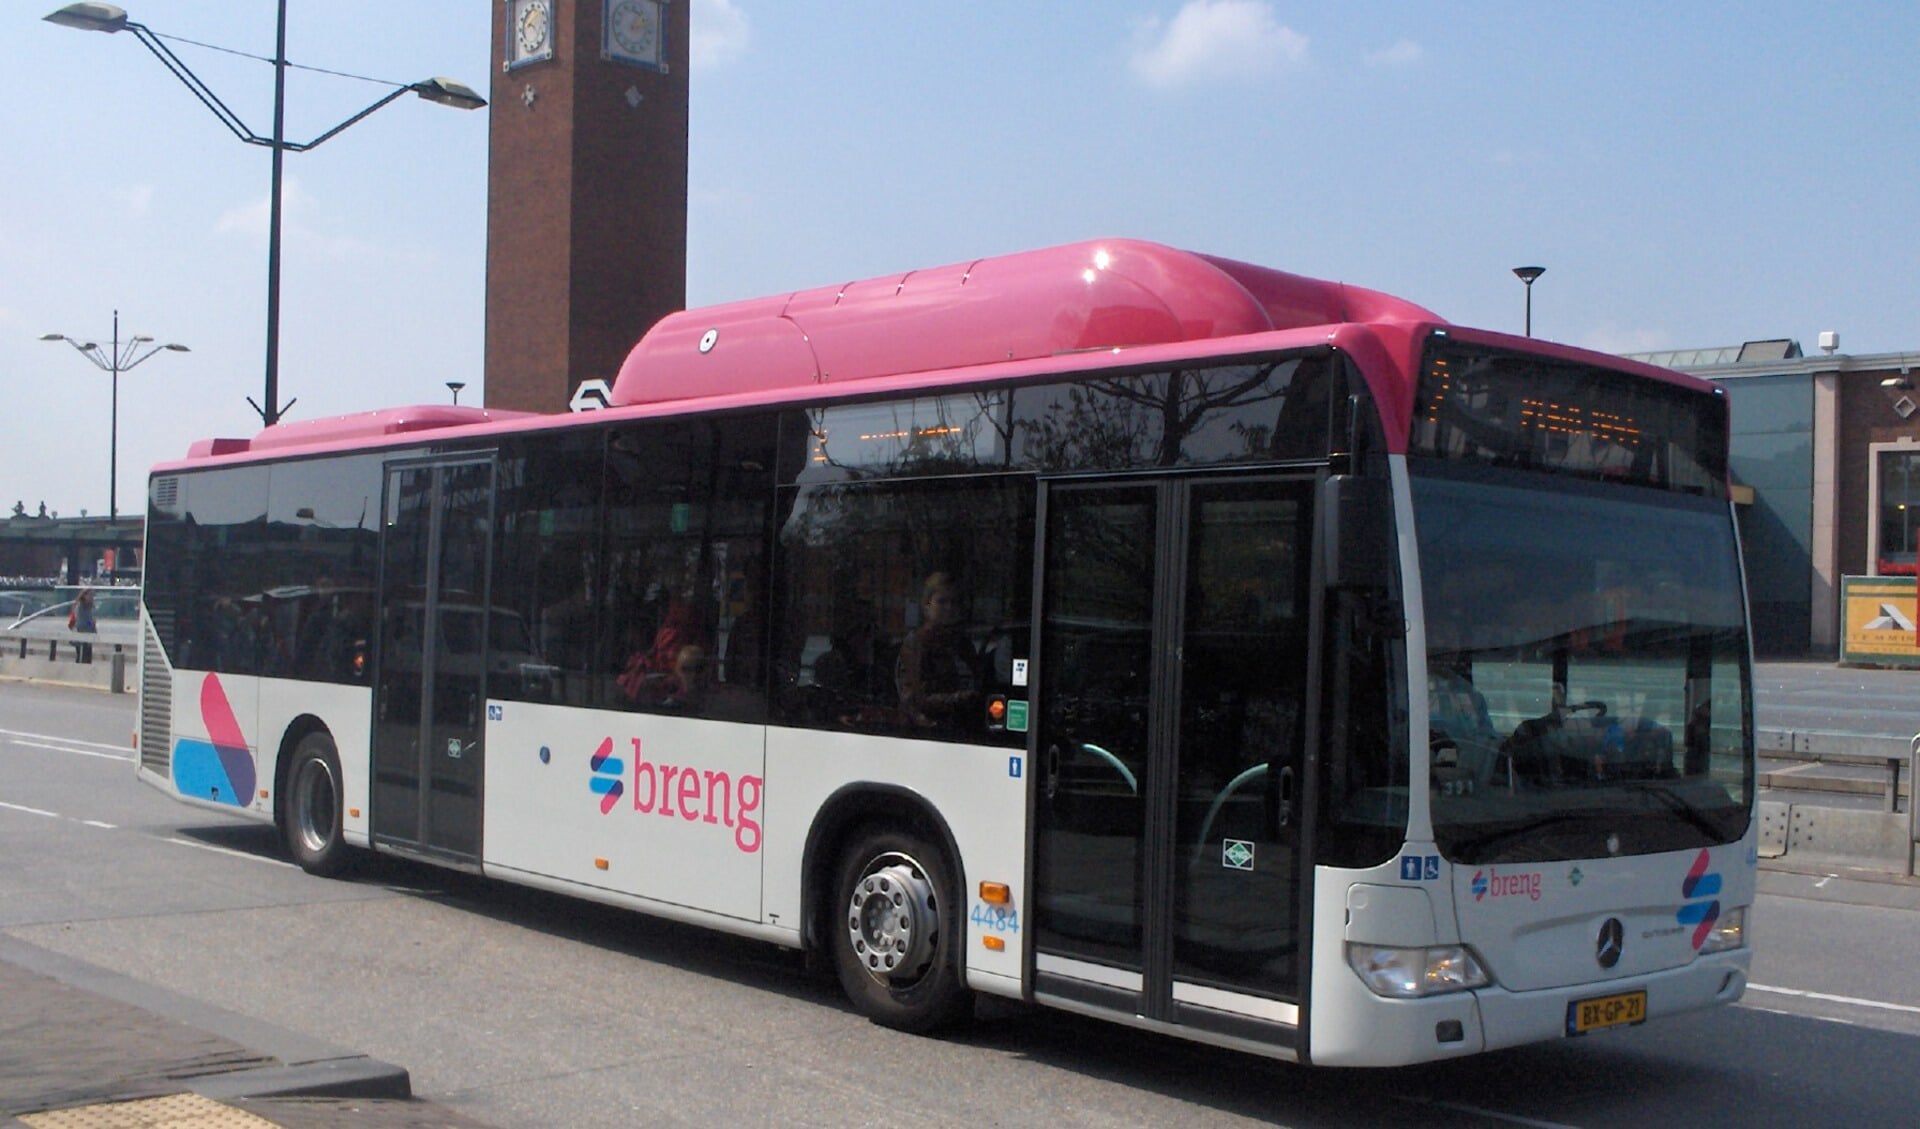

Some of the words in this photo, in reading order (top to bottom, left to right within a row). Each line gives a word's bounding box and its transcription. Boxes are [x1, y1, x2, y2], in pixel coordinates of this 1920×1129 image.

[631, 737, 763, 853] breng
[1490, 867, 1542, 901] breng
[971, 904, 1020, 934] 4484
[1583, 997, 1640, 1027] BX-GP-21
